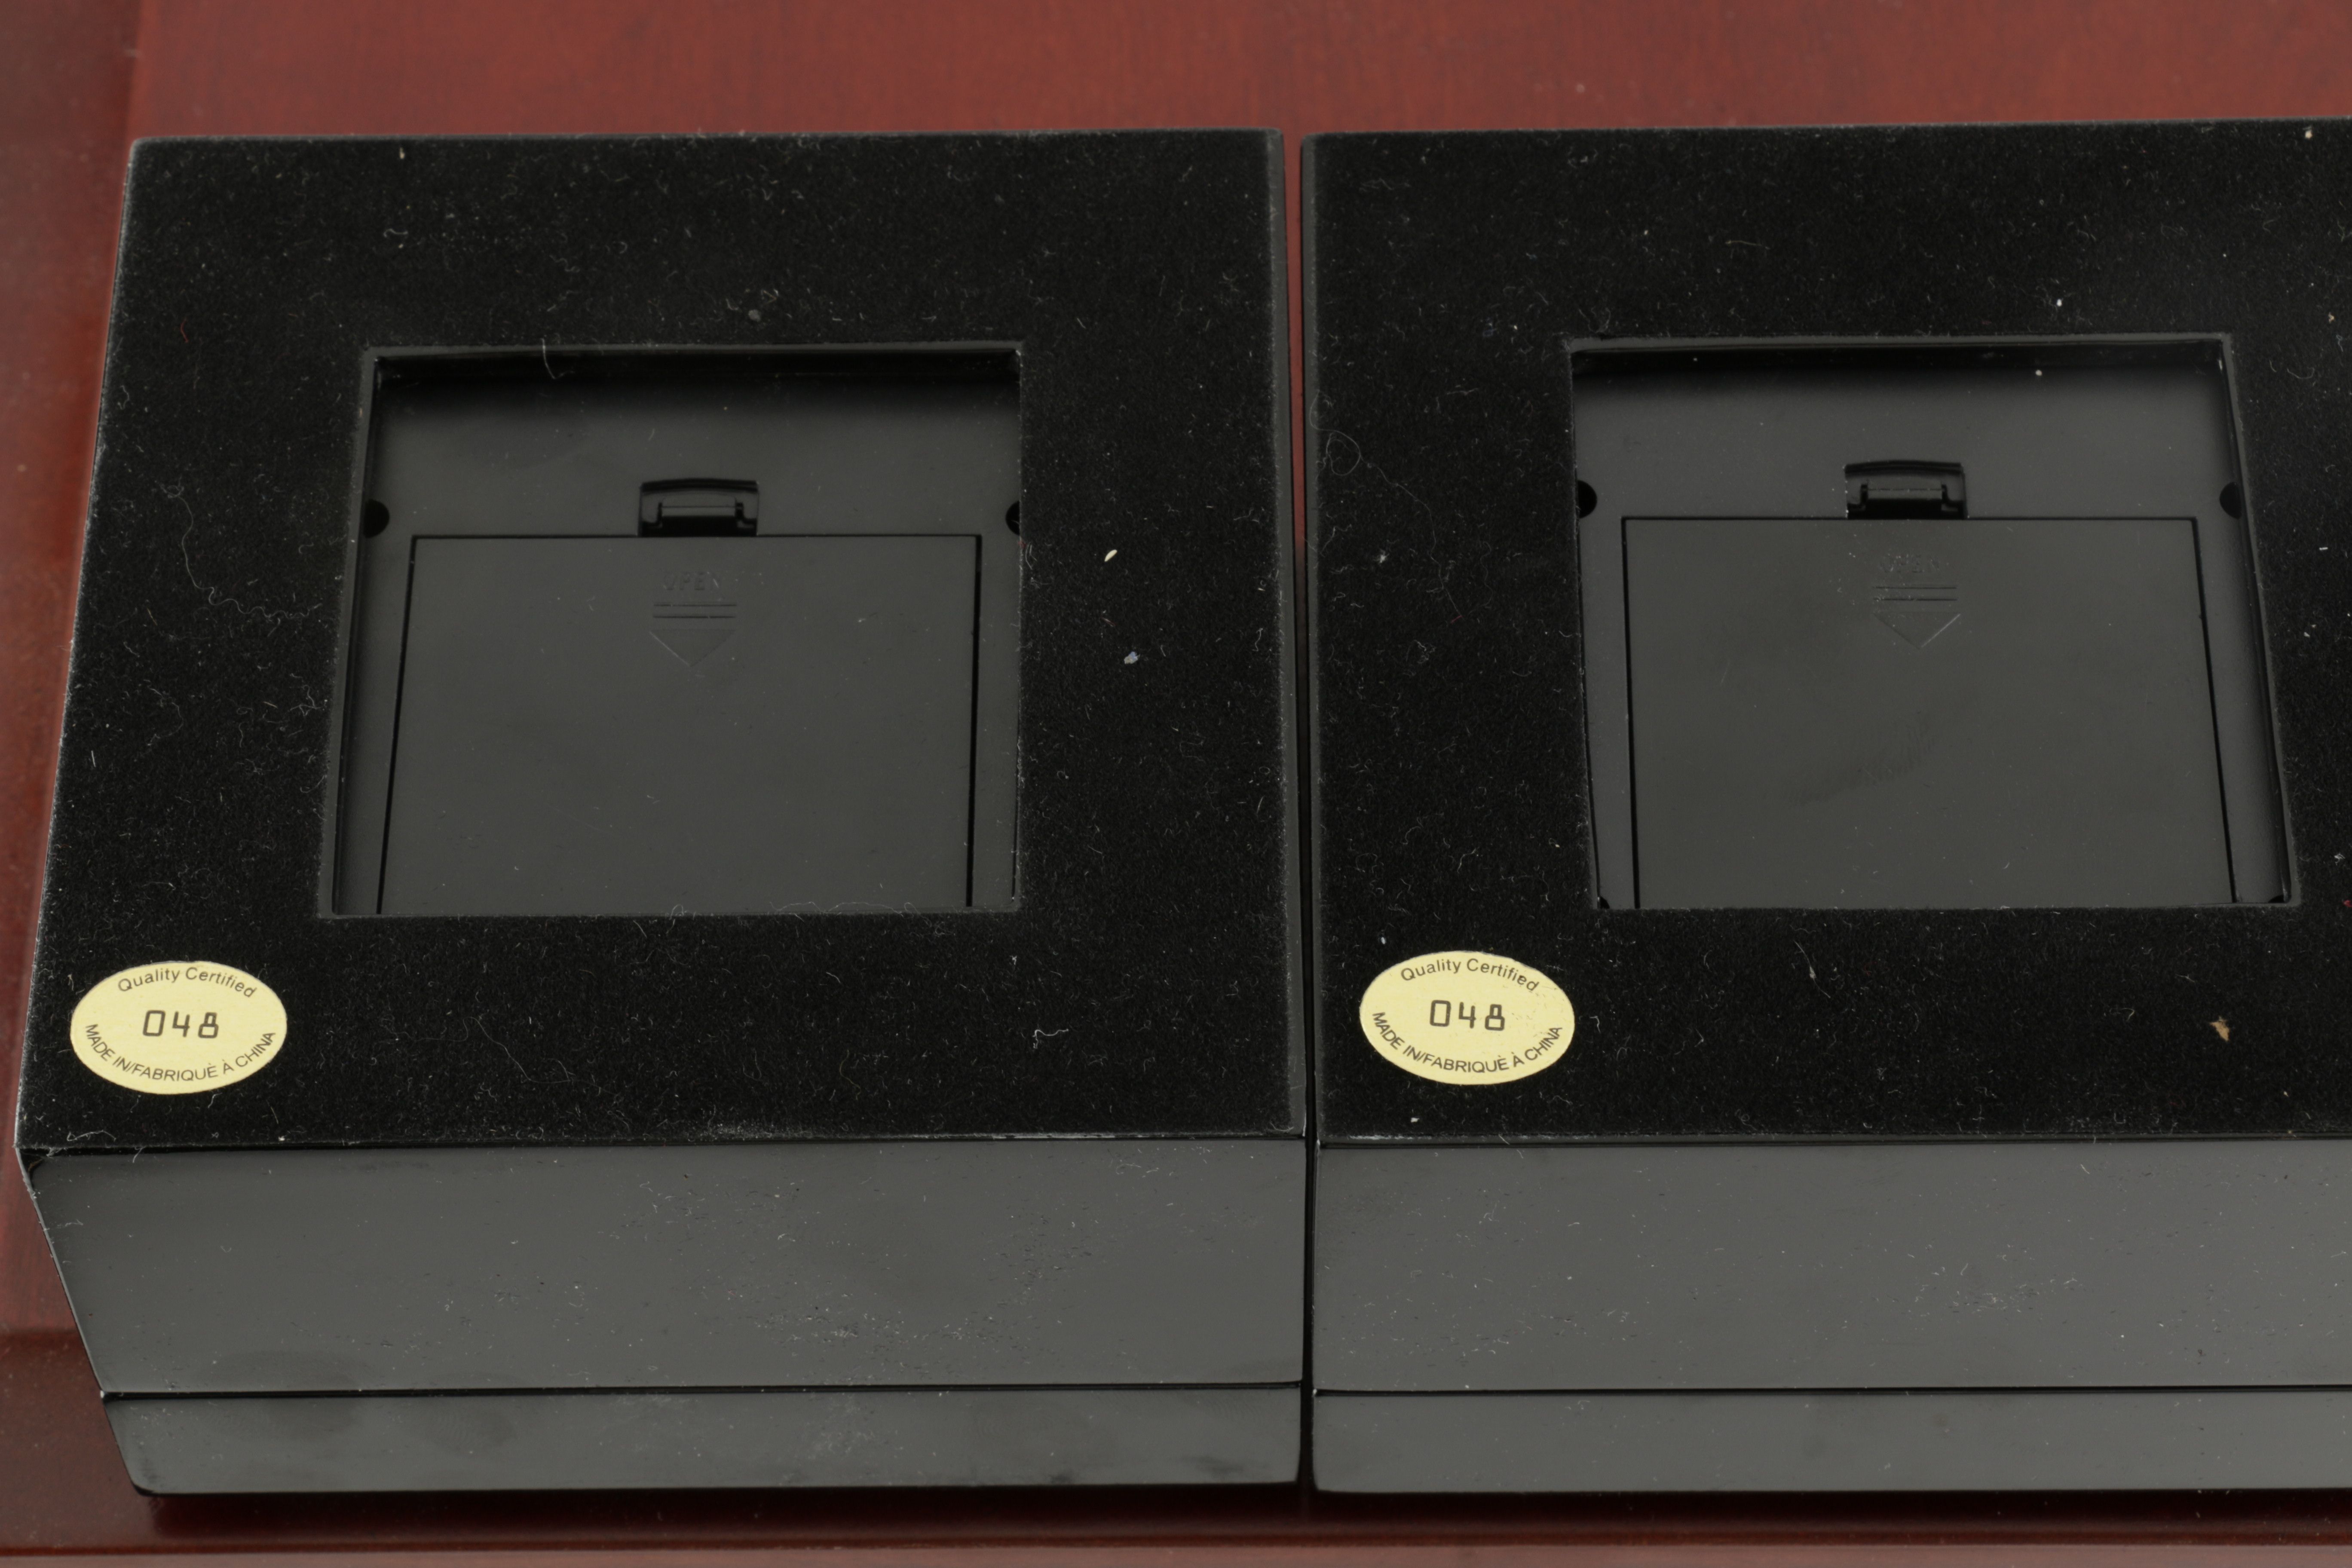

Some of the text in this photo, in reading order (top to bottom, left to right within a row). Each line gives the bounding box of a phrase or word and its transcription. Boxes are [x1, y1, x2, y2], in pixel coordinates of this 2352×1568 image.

[663, 571, 720, 591] OPEN
[118, 967, 257, 998] Quality Certified
[1400, 958, 1540, 992] Quality Certified
[142, 1010, 220, 1039] 048
[1429, 999, 1506, 1032] 048
[86, 1023, 115, 1061] MADE
[222, 1059, 234, 1075] À
[235, 1032, 276, 1068] CHINA
[1372, 1012, 1405, 1050] MADE
[1513, 1051, 1525, 1068] À
[1524, 1026, 1563, 1061] CHINA
